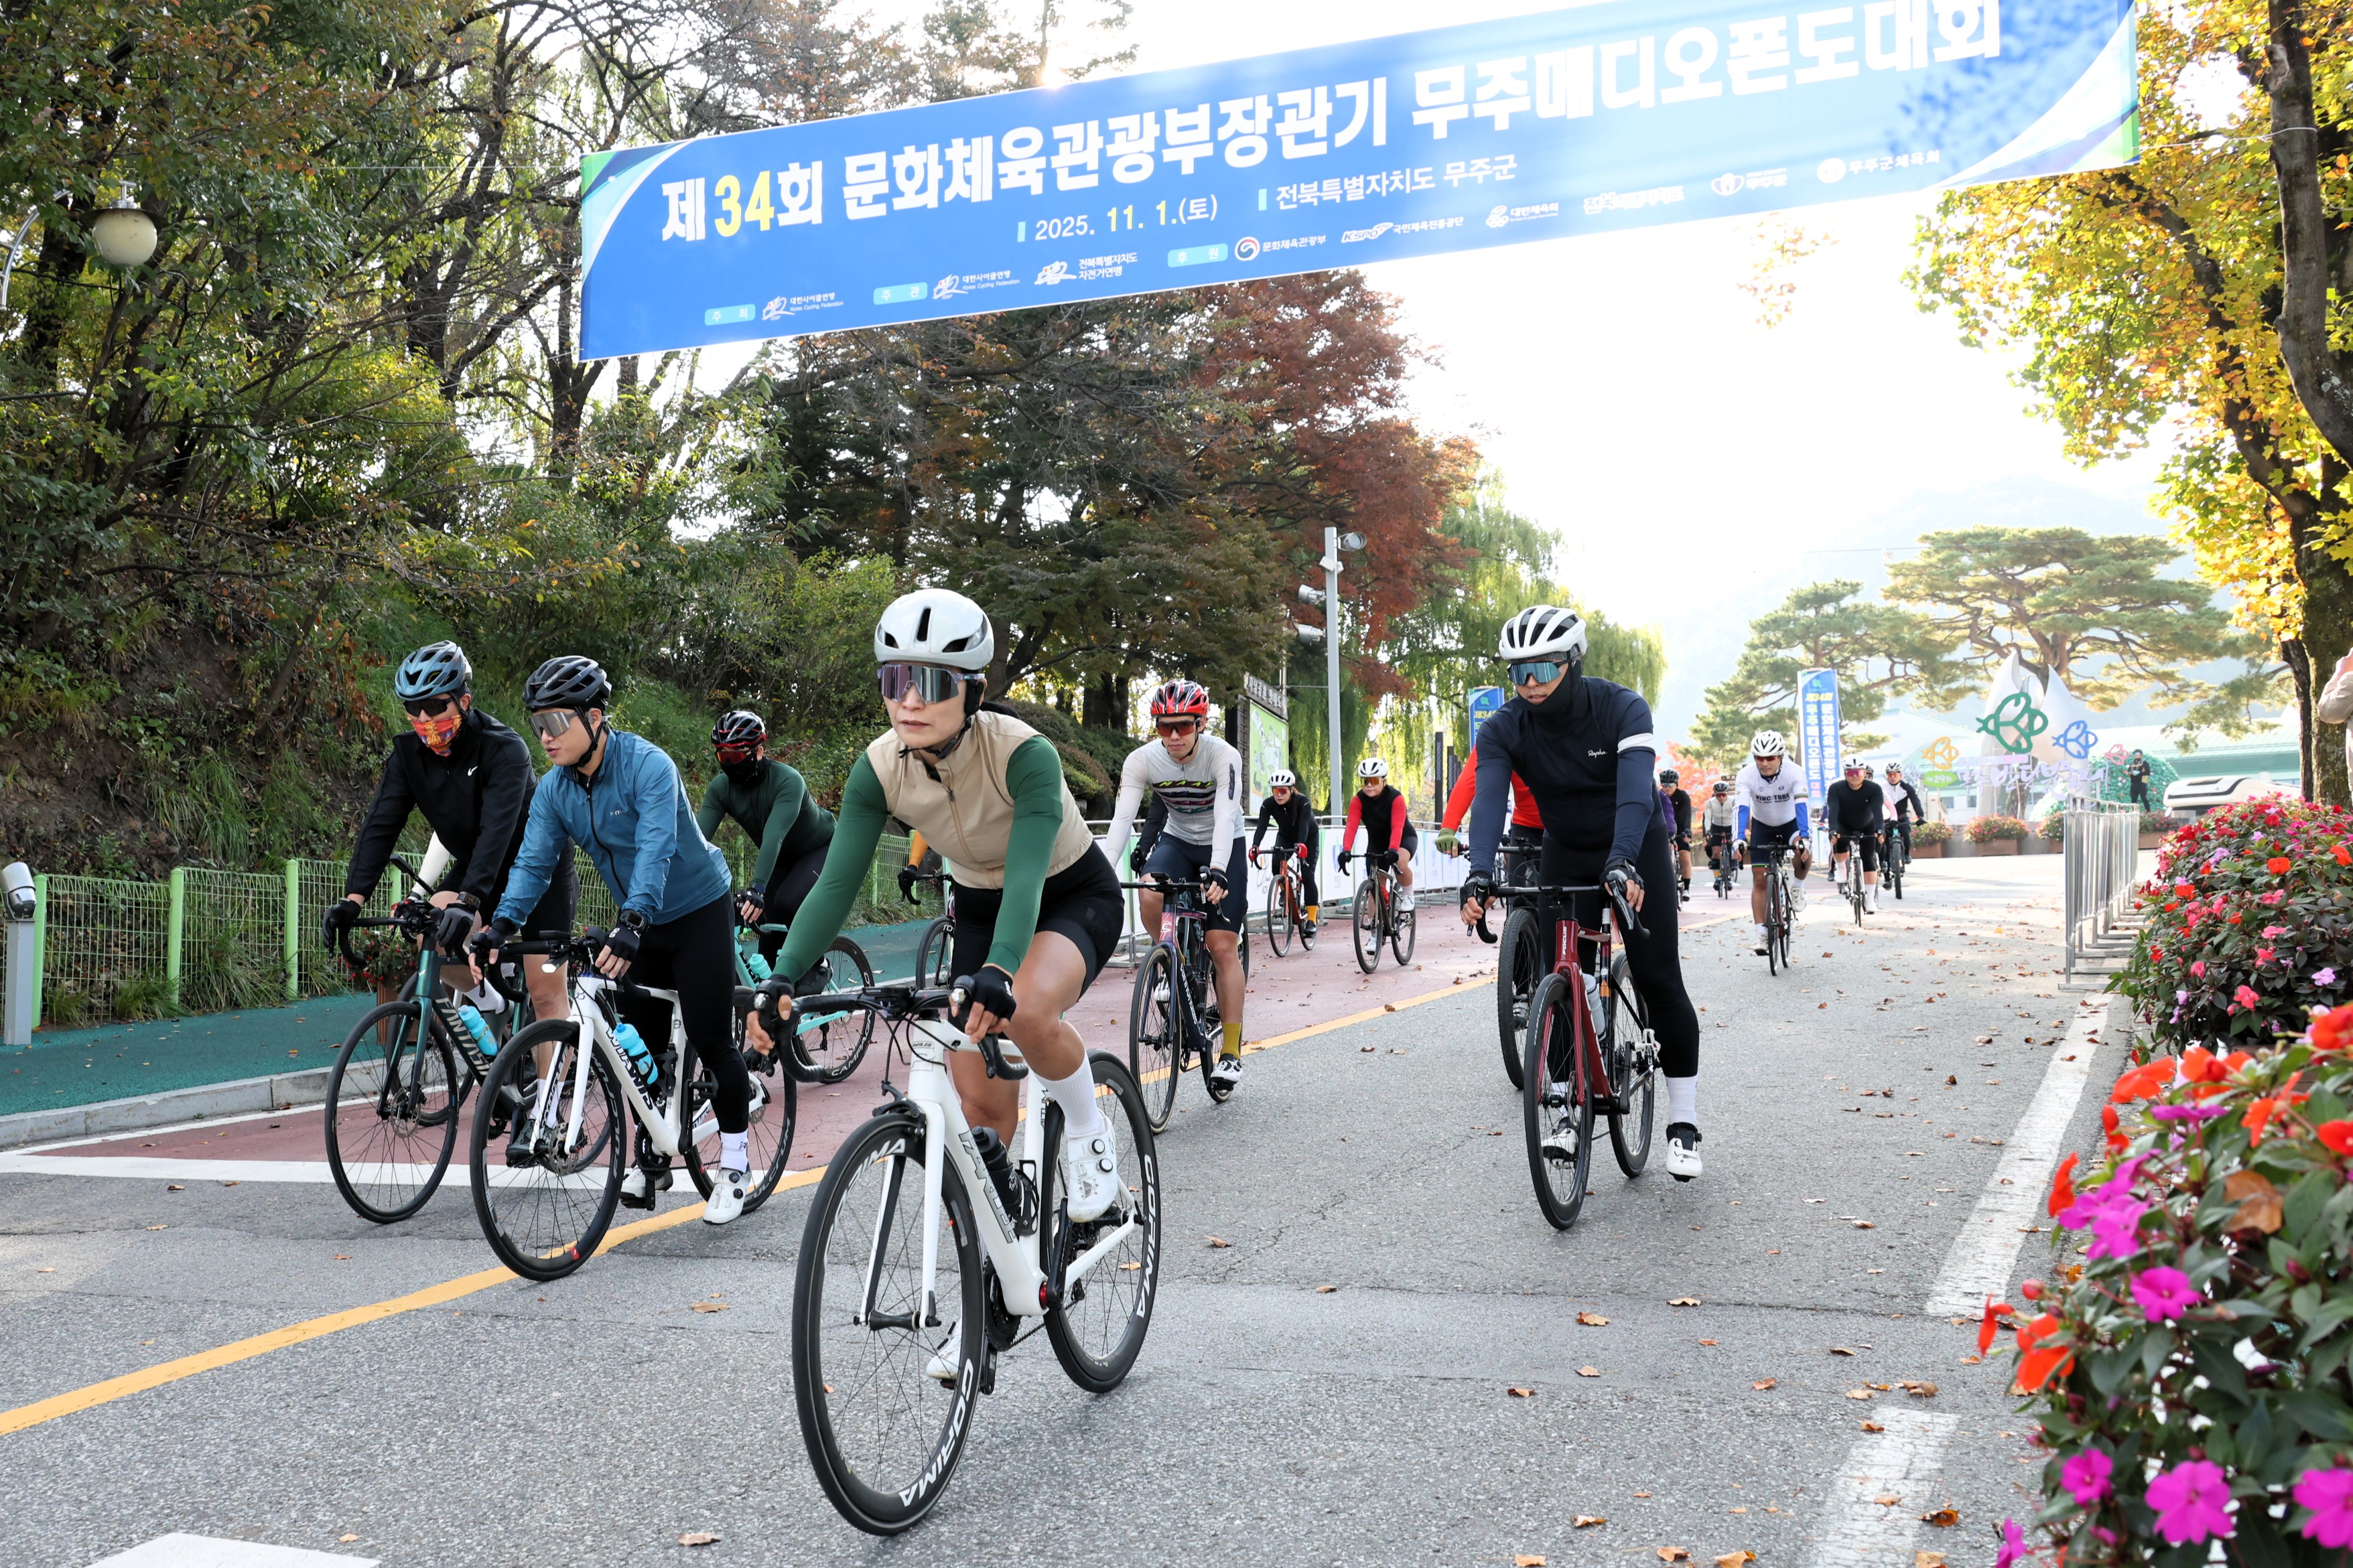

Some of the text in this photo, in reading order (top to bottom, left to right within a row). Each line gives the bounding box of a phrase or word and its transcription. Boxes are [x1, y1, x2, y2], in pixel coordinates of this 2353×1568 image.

[661, 0, 2001, 242] 제34회 문화체육관광부장관기 무주메디오폰도대회
[1848, 149, 1940, 175] 무주군체육회
[1275, 154, 1517, 210] 전북특별자치도 무주군
[1034, 194, 1218, 241] 2025. 11. 1.(토)
[1510, 202, 1559, 217] 대한체육회
[1393, 216, 1465, 234] 국민체육진흥공단
[1262, 234, 1327, 253] 문화체육관광부
[1342, 228, 1379, 242] KSPO
[1078, 252, 1138, 269] 전북특별자치도
[962, 271, 1011, 283] 대한사이클연맹
[1078, 265, 1123, 280] 자전거연맹
[977, 281, 994, 289] Cycling
[996, 279, 1020, 288] Federation
[789, 292, 835, 305] 대한사이클연맹
[820, 300, 844, 310] Federation
[1474, 710, 1497, 719] 제34
[435, 997, 491, 1076] FANTASI
[744, 1117, 791, 1202] FULCRUM
[1136, 1154, 1156, 1318] CORIMA
[898, 1358, 973, 1507] CORIMA
